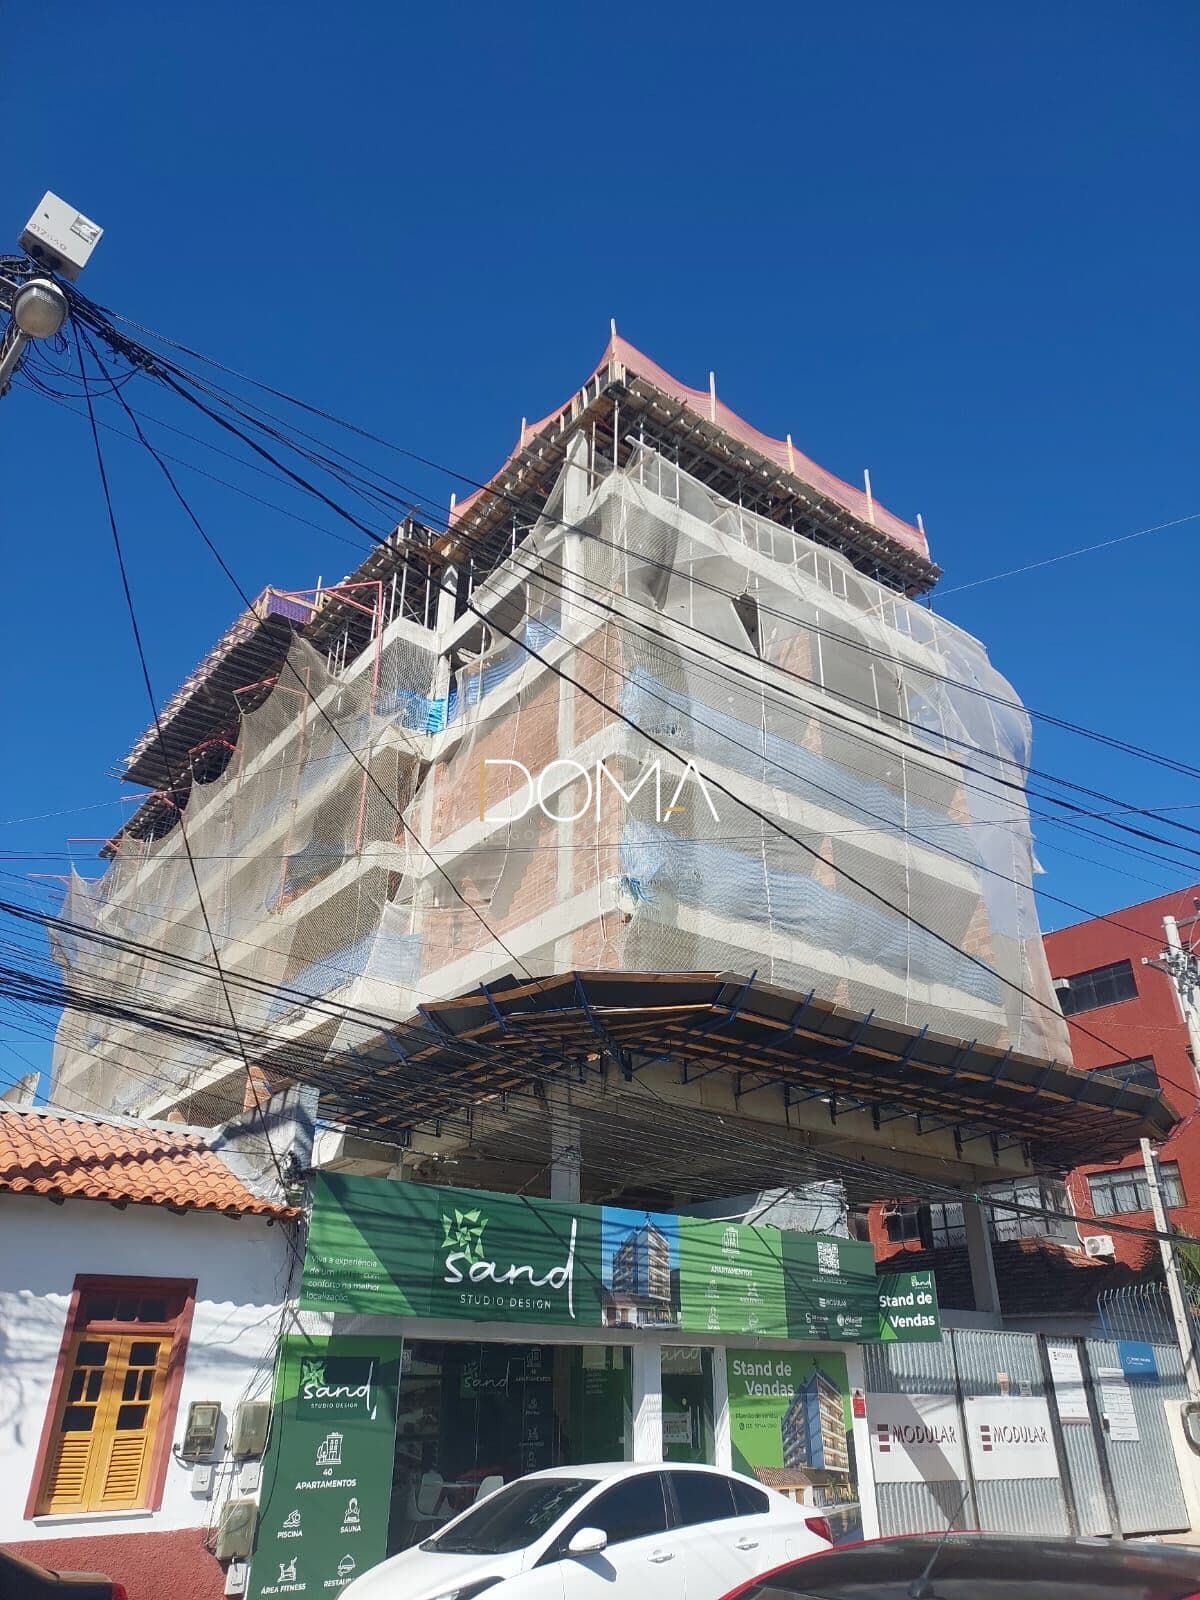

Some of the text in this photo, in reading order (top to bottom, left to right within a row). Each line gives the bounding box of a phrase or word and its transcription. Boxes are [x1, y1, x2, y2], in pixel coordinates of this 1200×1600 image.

[309, 1266, 320, 1274] de
[444, 1217, 577, 1319] sand
[460, 1294, 552, 1309] STUDIO DESIGN
[879, 1291, 933, 1308] Stand de
[889, 1313, 936, 1328] Vendas
[732, 1359, 792, 1377] Stand de
[304, 1361, 374, 1411] sand
[744, 1379, 795, 1397] Vendas
[892, 1424, 957, 1444] MODULAR
[993, 1425, 1049, 1444] MODULAR
[322, 1467, 333, 1477] 40
[296, 1478, 357, 1490] APARTAMENTOS
[277, 1529, 303, 1539] PISCINA
[340, 1525, 361, 1534] SAUNA
[260, 1583, 306, 1595] ÁREA FITNESS
